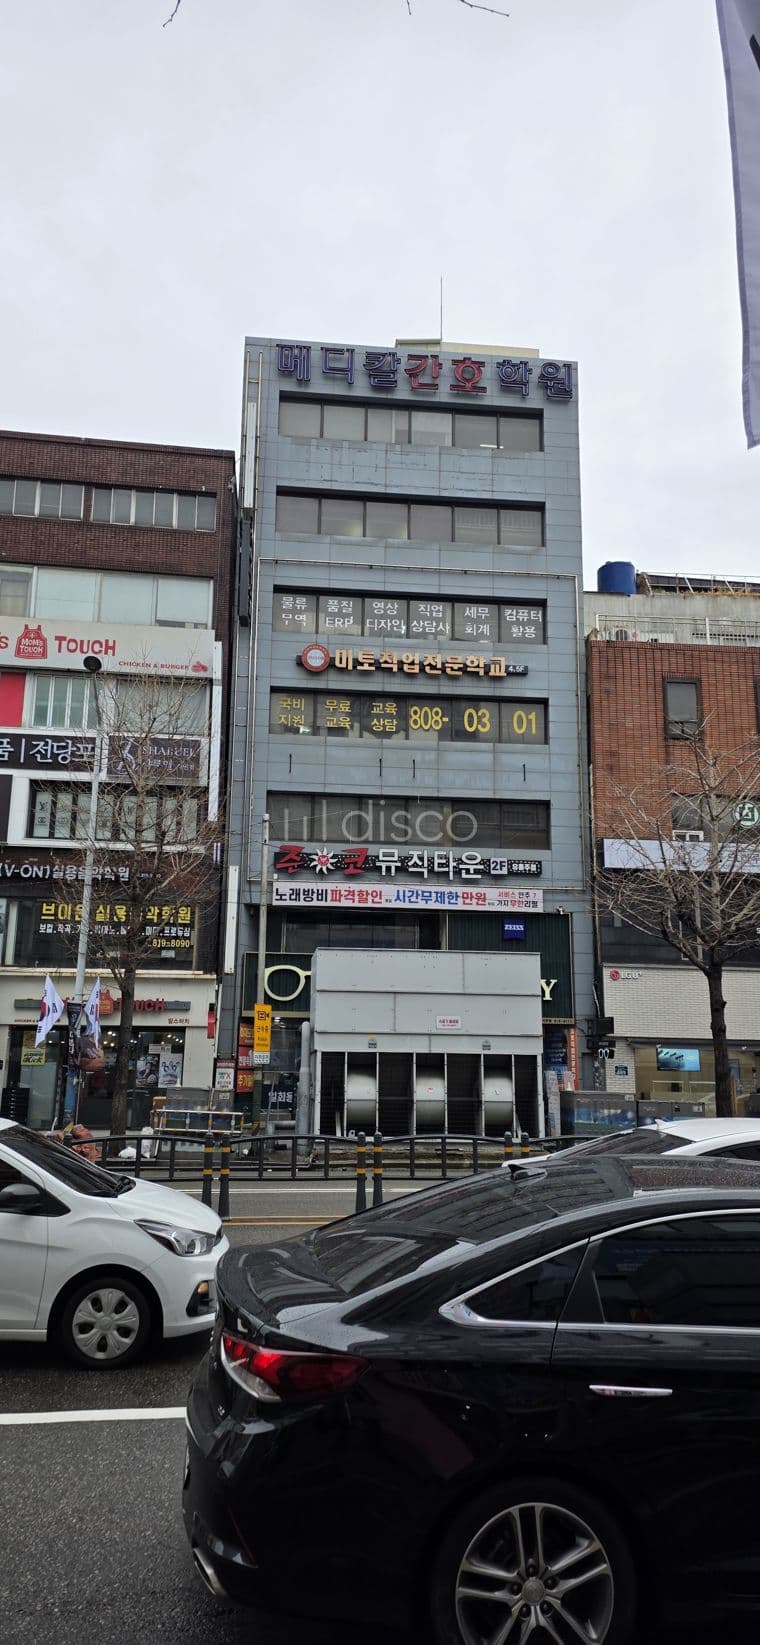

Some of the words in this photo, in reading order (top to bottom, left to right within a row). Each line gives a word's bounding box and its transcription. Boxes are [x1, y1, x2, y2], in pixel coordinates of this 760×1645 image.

[281, 597, 307, 610] 물류
[326, 600, 353, 613] 품질
[373, 602, 398, 615] 영상
[418, 605, 443, 617] 직업
[464, 607, 490, 619] 세무
[504, 609, 542, 622] 컴퓨터
[325, 616, 353, 628] ERP
[366, 618, 405, 631] 디자인
[411, 620, 450, 633] 상담사
[465, 623, 490, 635] 회계
[511, 625, 536, 638] 활용
[55, 635, 116, 657] TOUCH
[119, 660, 151, 668] CHICKEN
[335, 649, 507, 677] 미토직업전문학교
[325, 699, 351, 712] 무료
[371, 702, 398, 715] 교육
[410, 706, 449, 730] 808-
[463, 708, 491, 732] 03
[513, 710, 536, 734] 01
[325, 716, 351, 729] 교육
[371, 718, 398, 732] 상담
[29, 738, 97, 764] 전당포
[376, 848, 484, 880] 뮤직타운
[492, 861, 506, 871] 2F
[274, 888, 328, 903] 노래방비
[330, 886, 383, 904] 파격할인
[394, 888, 459, 905] 시간무제한
[461, 891, 487, 906] 만원
